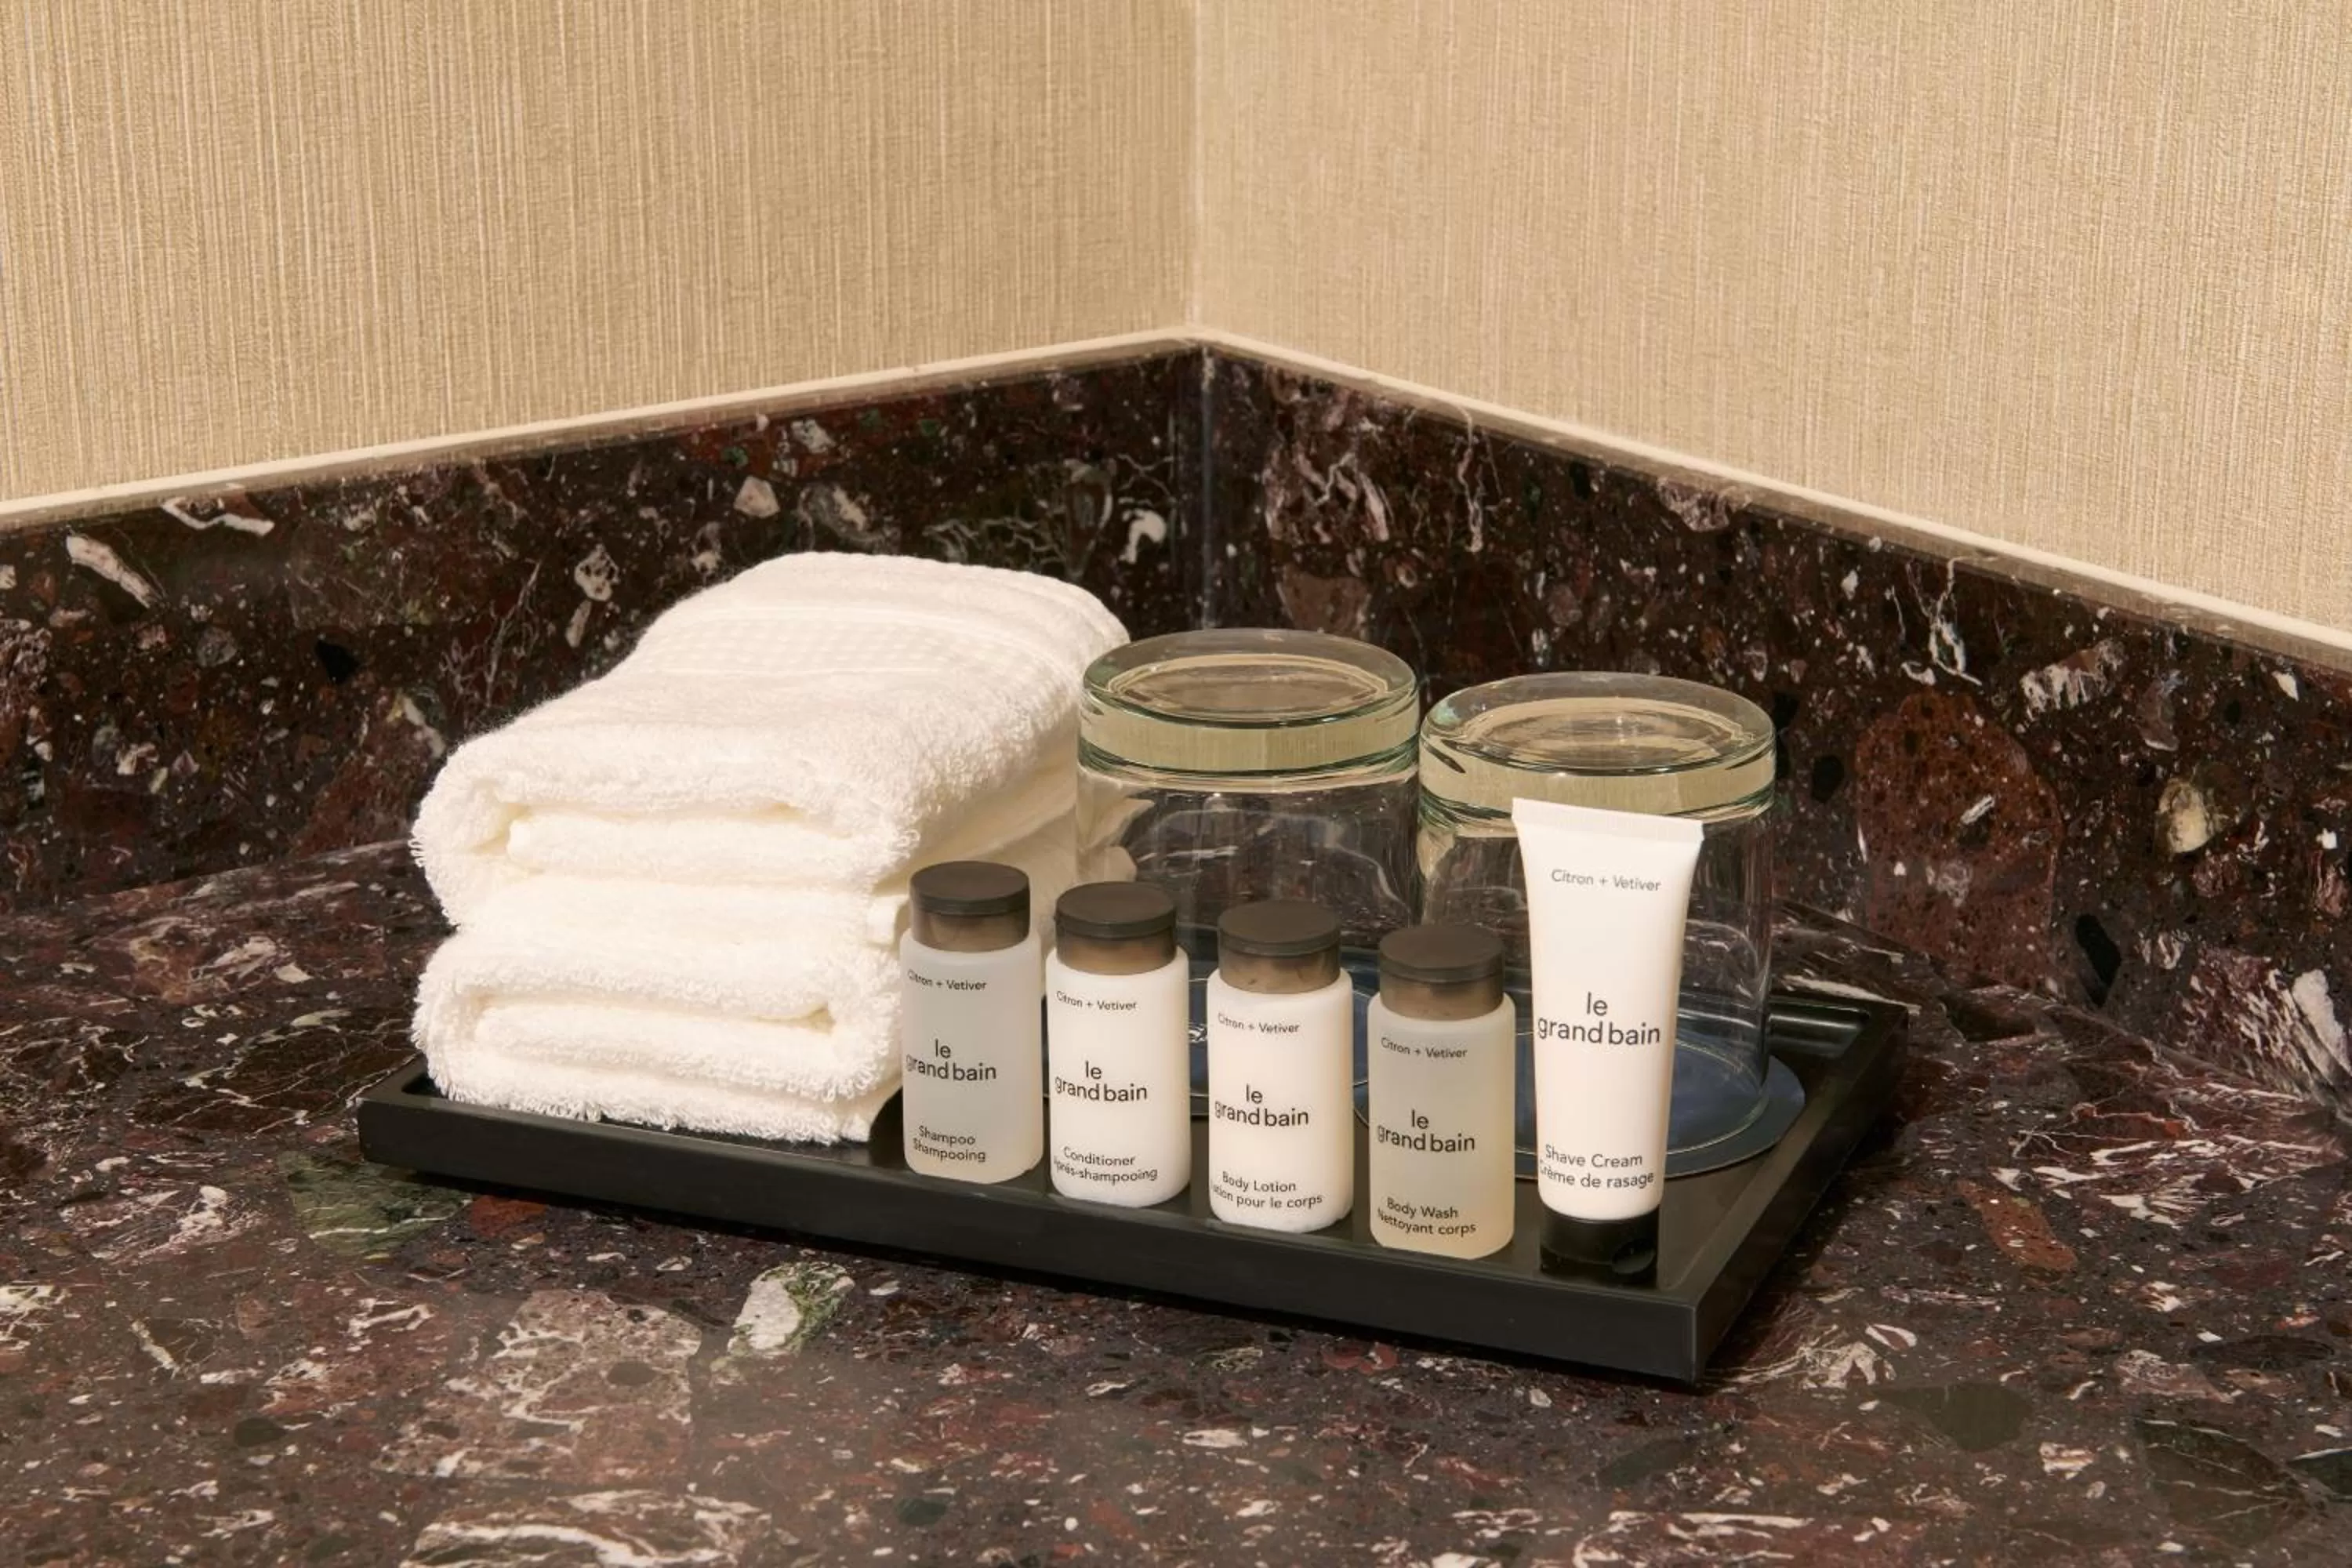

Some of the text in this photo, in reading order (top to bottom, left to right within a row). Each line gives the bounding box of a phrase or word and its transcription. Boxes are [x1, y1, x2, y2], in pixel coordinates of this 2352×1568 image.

[1552, 869, 1661, 891] Citron + Vetiver
[946, 980, 987, 990] Vetiver
[1056, 990, 1083, 1007] Citron
[1098, 1000, 1137, 1010] Vetiver
[1587, 991, 1607, 1016] le
[1218, 1012, 1244, 1029] Citron
[1258, 1022, 1299, 1033] Vetiver
[1537, 1018, 1660, 1045] grand bain
[935, 1038, 951, 1058] le
[1381, 1037, 1410, 1054] Citron
[1425, 1047, 1468, 1058] Vetiver
[953, 1062, 996, 1081] bain
[1086, 1060, 1102, 1080] le
[1055, 1076, 1147, 1102] grand bain
[1246, 1083, 1263, 1104] le
[1215, 1100, 1308, 1127] grand bain
[1412, 1109, 1428, 1129] le
[918, 1124, 976, 1147] Shampoo
[1377, 1124, 1475, 1152] grand bain
[1063, 1146, 1135, 1166] Conditioner
[1545, 1144, 1643, 1167] Shave Cream
[1222, 1171, 1296, 1192] Body Lotion
[1580, 1173, 1601, 1188] de
[1607, 1172, 1654, 1189] rasage
[1236, 1195, 1265, 1207] pour
[1270, 1197, 1283, 1208] le
[1287, 1195, 1323, 1209] corps
[1387, 1196, 1460, 1219] Body Wash
[1438, 1224, 1477, 1238] corps
